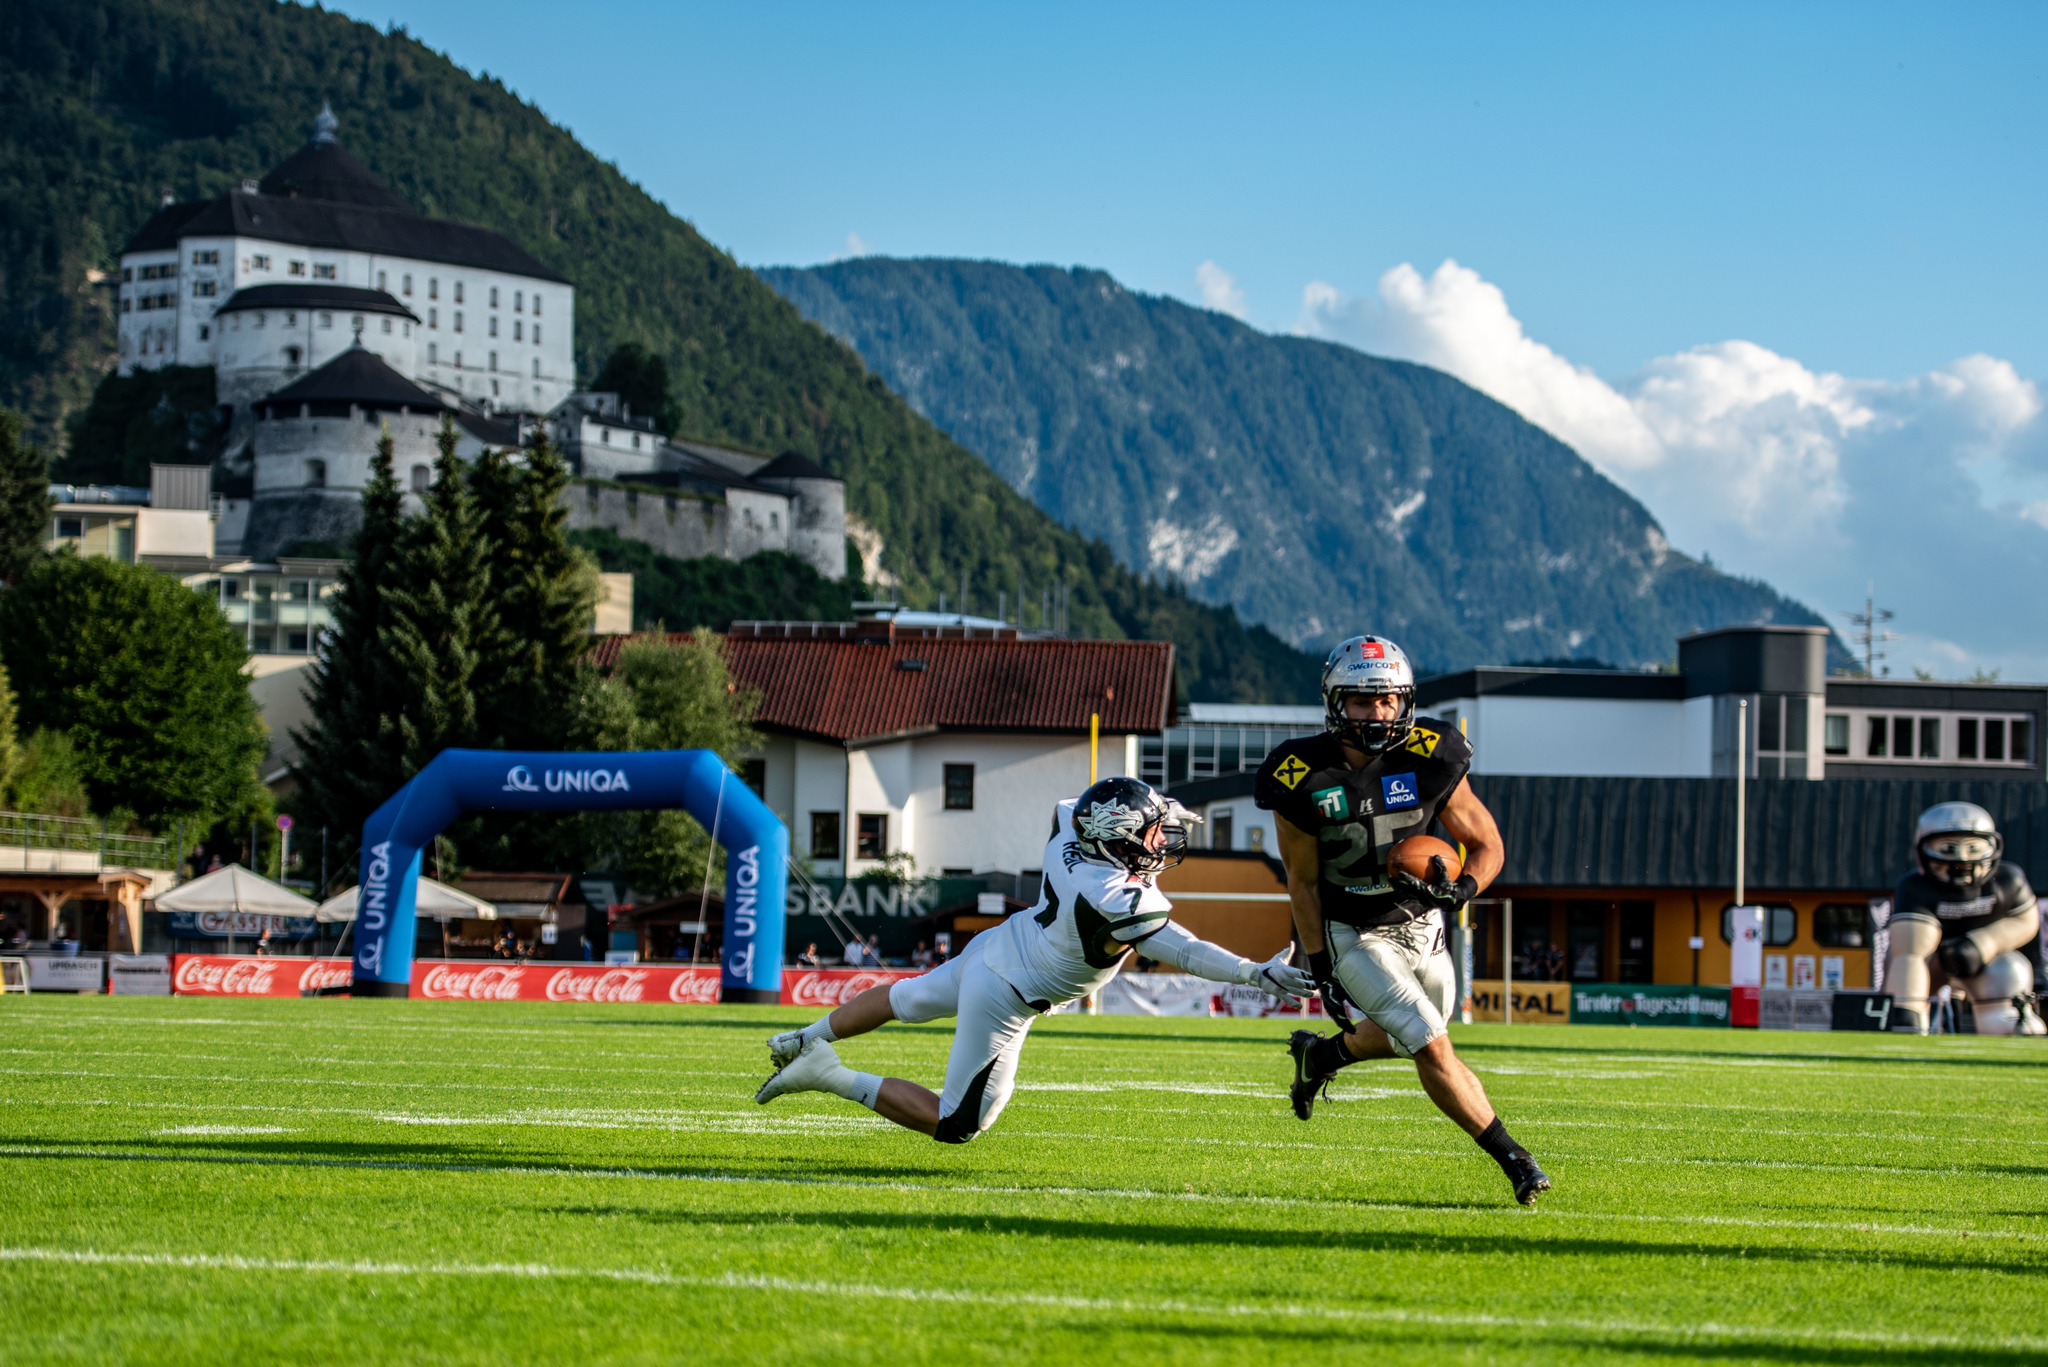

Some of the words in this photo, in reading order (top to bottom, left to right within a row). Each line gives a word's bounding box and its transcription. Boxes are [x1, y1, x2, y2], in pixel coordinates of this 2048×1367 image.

[1348, 662, 1388, 671] swarco
[545, 769, 630, 792] UNIQA
[1386, 793, 1416, 805] UNIQA
[364, 840, 392, 930] UNIQA
[734, 845, 760, 937] UNIQA
[1122, 887, 1142, 915] 7
[175, 957, 280, 993] Coca-Cola
[422, 965, 527, 999] Coca-Cola
[546, 968, 649, 1001] Coca-Cola
[1575, 992, 1621, 1013] Tiroler
[1632, 993, 1727, 1019] Tageszeitung
[1864, 998, 1890, 1030] 4
